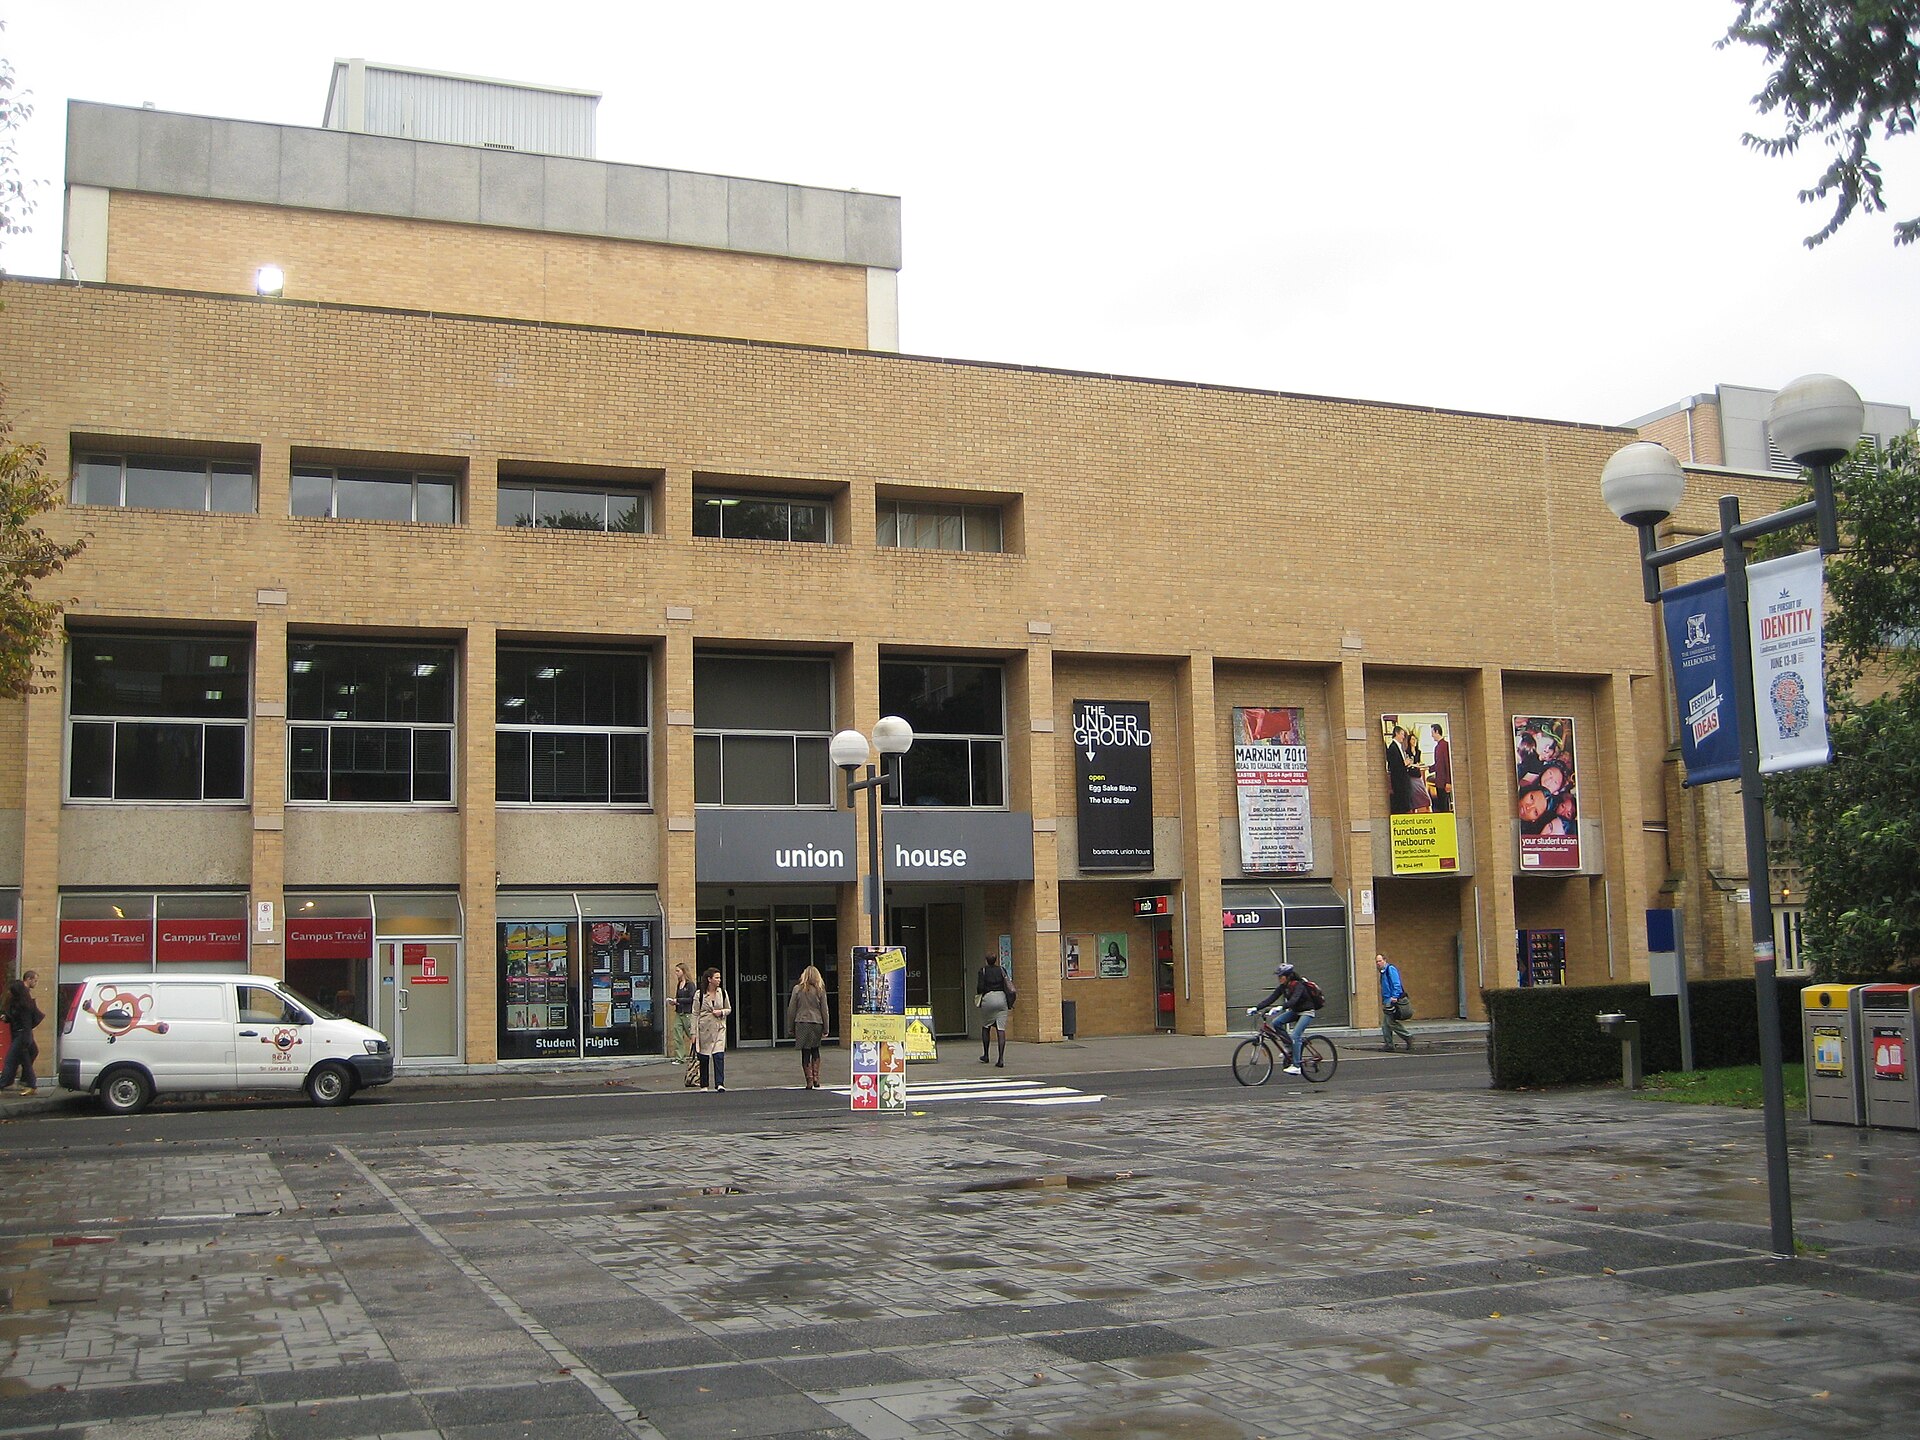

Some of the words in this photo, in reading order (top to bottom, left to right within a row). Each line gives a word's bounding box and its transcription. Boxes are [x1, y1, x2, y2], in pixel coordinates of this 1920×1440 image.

[1777, 600, 1795, 611] PURSUIT
[1760, 608, 1812, 640] IDENTITY
[1682, 654, 1716, 668] MELBOURNE
[1770, 656, 1782, 669] JUNE
[1692, 689, 1714, 710] FESTIVAL
[1084, 706, 1105, 715] THE
[1073, 714, 1137, 731] UNDER
[1694, 713, 1717, 739] IDEAS
[1074, 730, 1152, 746] GROUND
[1236, 748, 1280, 762] MARXISM
[1284, 748, 1306, 762] 2011
[1089, 784, 1102, 792] Egg
[1394, 826, 1428, 836] functions
[1394, 838, 1436, 846] melbourne
[1522, 838, 1536, 846] your
[775, 842, 844, 868] union
[896, 844, 966, 867] house
[1140, 900, 1152, 910] nab
[1236, 911, 1260, 924] nab
[64, 934, 110, 945] Campus
[112, 934, 144, 943] Travel
[162, 933, 206, 944] Campus
[208, 932, 240, 942] Travel
[292, 932, 333, 942] Campus
[335, 931, 366, 940] Travel
[740, 973, 768, 982] house
[918, 1008, 932, 1016] OUT
[536, 1038, 576, 1048] Student
[586, 1037, 620, 1048] Flights
